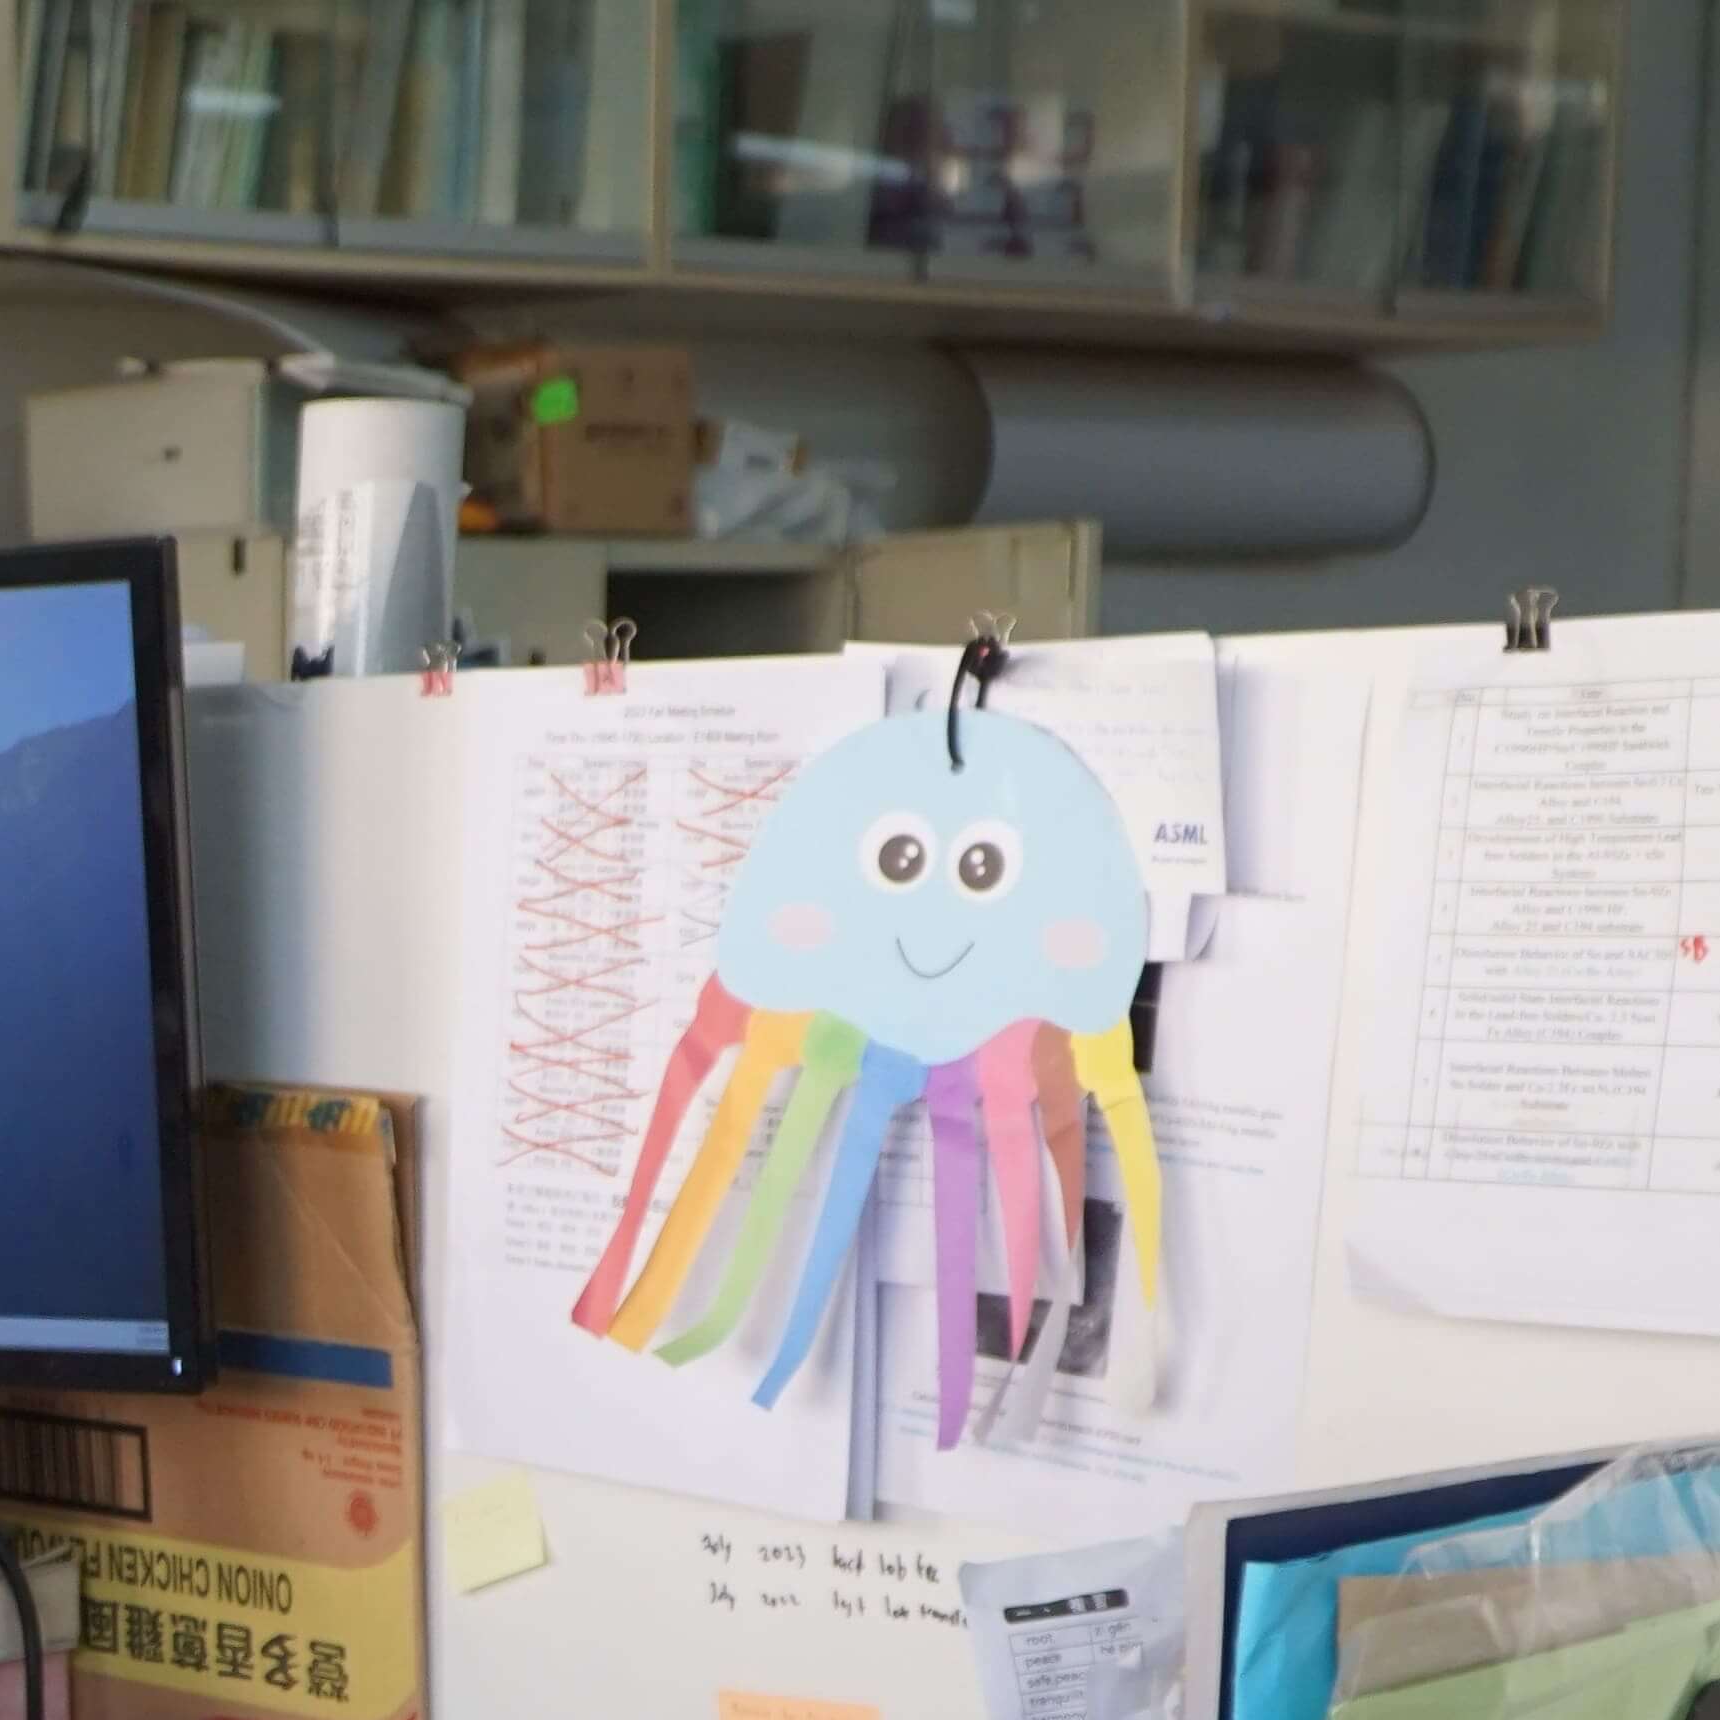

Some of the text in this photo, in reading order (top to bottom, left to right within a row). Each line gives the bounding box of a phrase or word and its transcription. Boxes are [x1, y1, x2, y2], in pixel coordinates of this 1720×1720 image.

[1153, 822, 1208, 845] ASML
[106, 1542, 211, 1599] CHICKEN
[215, 1562, 294, 1616] ONION
